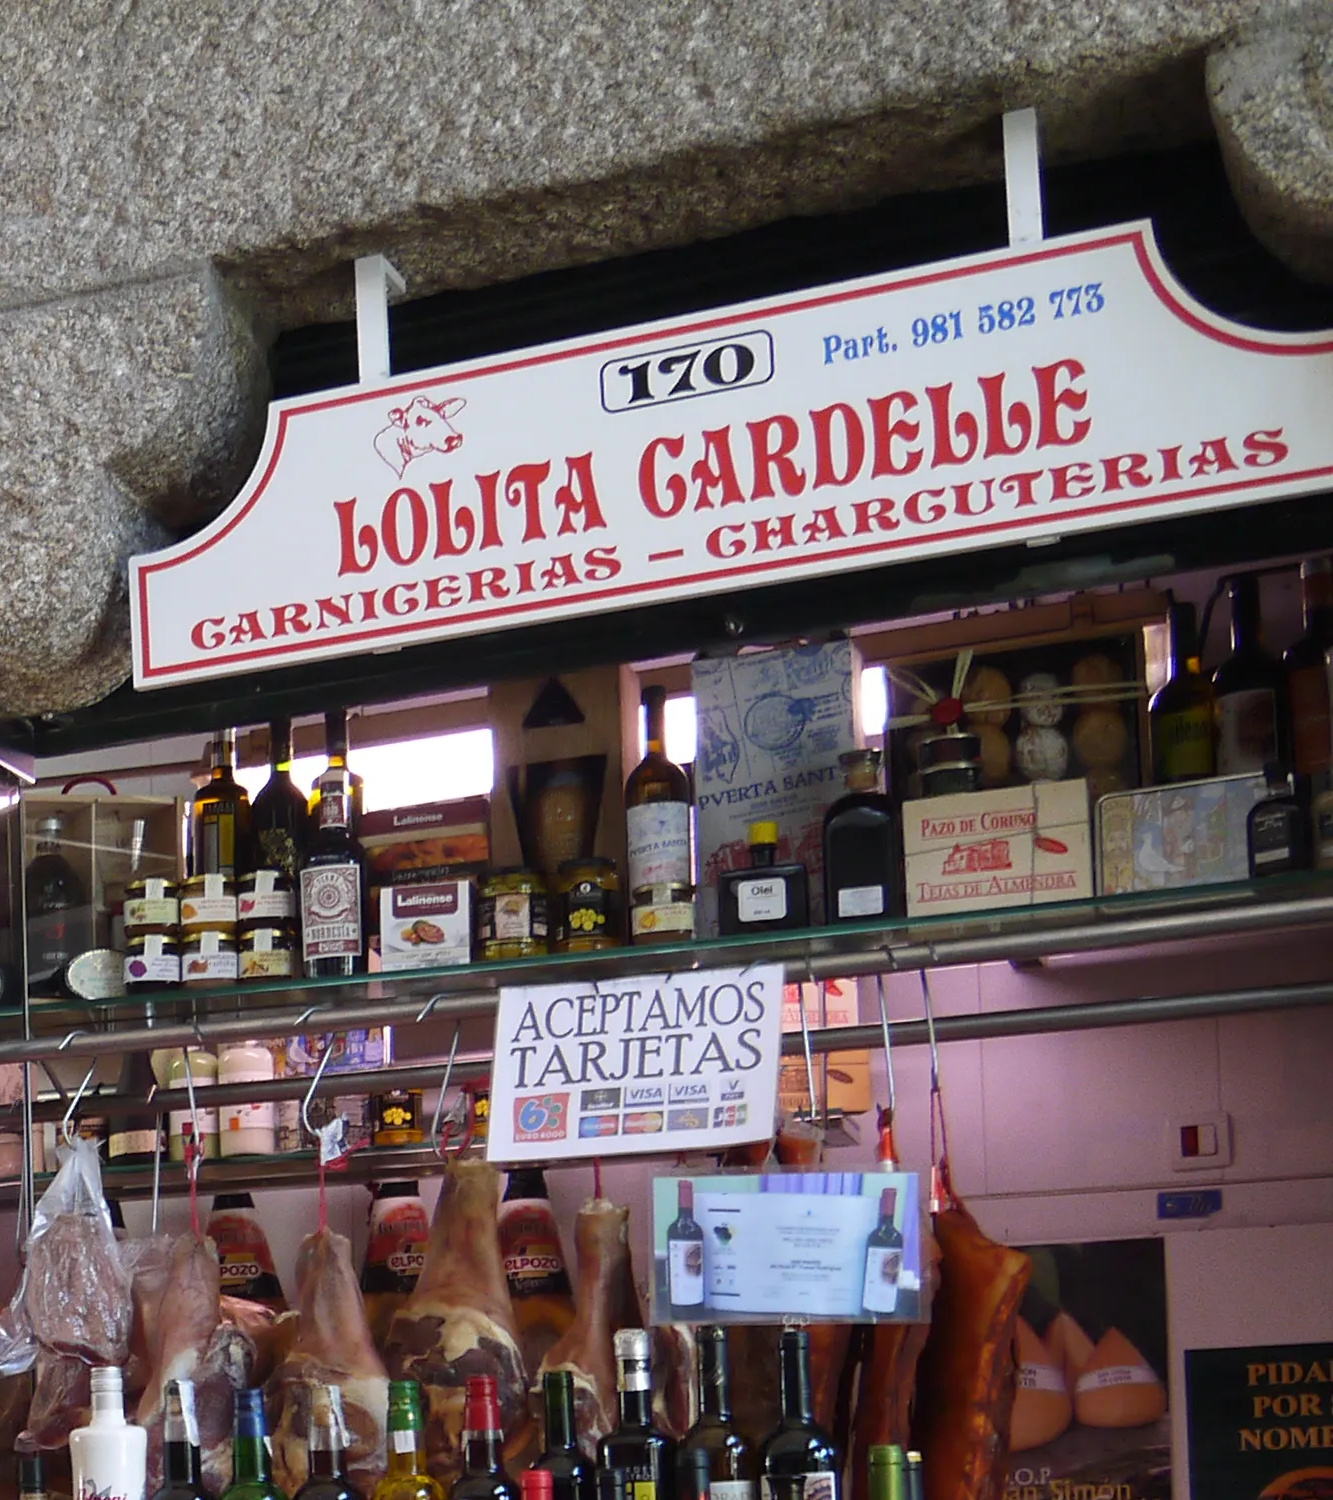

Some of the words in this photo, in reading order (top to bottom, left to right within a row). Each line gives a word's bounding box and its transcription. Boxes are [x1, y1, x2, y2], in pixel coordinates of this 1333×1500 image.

[821, 329, 899, 368] Part.
[911, 307, 965, 349] 981
[977, 294, 1038, 334] 582
[1049, 282, 1107, 322] 773
[616, 345, 754, 405] 170
[333, 449, 606, 579] LOLITA
[637, 356, 1093, 524] CARDELLE
[189, 545, 623, 654] CARNICERIAS
[704, 426, 1291, 562] CHARCUTERIAS
[783, 765, 840, 790] SANT
[393, 812, 444, 827] Lalinense
[920, 815, 958, 838] PAZO
[960, 817, 978, 834] DE
[750, 884, 773, 896] Olei
[917, 881, 962, 902] TEJAS
[964, 879, 983, 898] DE
[989, 871, 1078, 896] ALMENDRA
[396, 893, 454, 908] Lalinense
[511, 981, 765, 1042] ACEPTAMOS
[510, 1028, 762, 1088] TARJETAS
[629, 1087, 663, 1100] VISA
[674, 1084, 708, 1096] VISA
[220, 1264, 260, 1278] POZO
[1247, 1362, 1333, 1387] PIDA
[1253, 1394, 1322, 1419] POR
[1004, 1468, 1051, 1487] .O.P.
